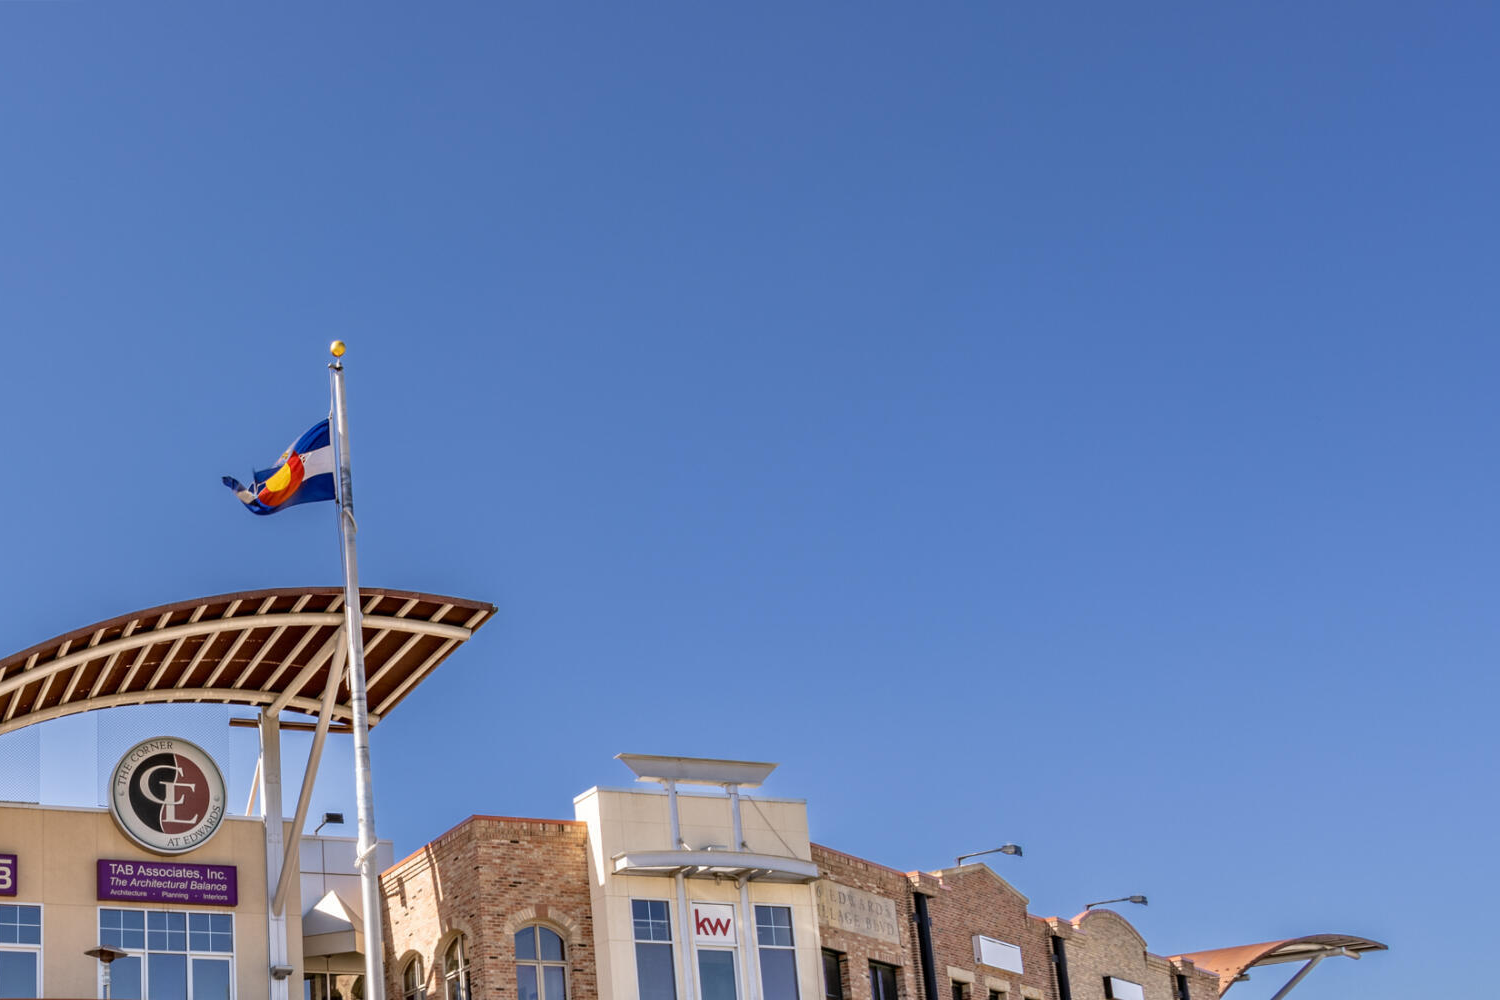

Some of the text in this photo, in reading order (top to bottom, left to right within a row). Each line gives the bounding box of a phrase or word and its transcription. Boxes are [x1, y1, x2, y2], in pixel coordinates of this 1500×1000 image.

[117, 741, 173, 787] THE CORNER
[167, 804, 221, 848] AT EDWARDS
[109, 863, 228, 880] TAB Associates, Inc.
[109, 877, 228, 892] The Architectural Balance
[110, 889, 228, 901] Architecture Planning Interiors
[694, 908, 732, 937] kw
[817, 903, 895, 936] ILLAGE BLVD
